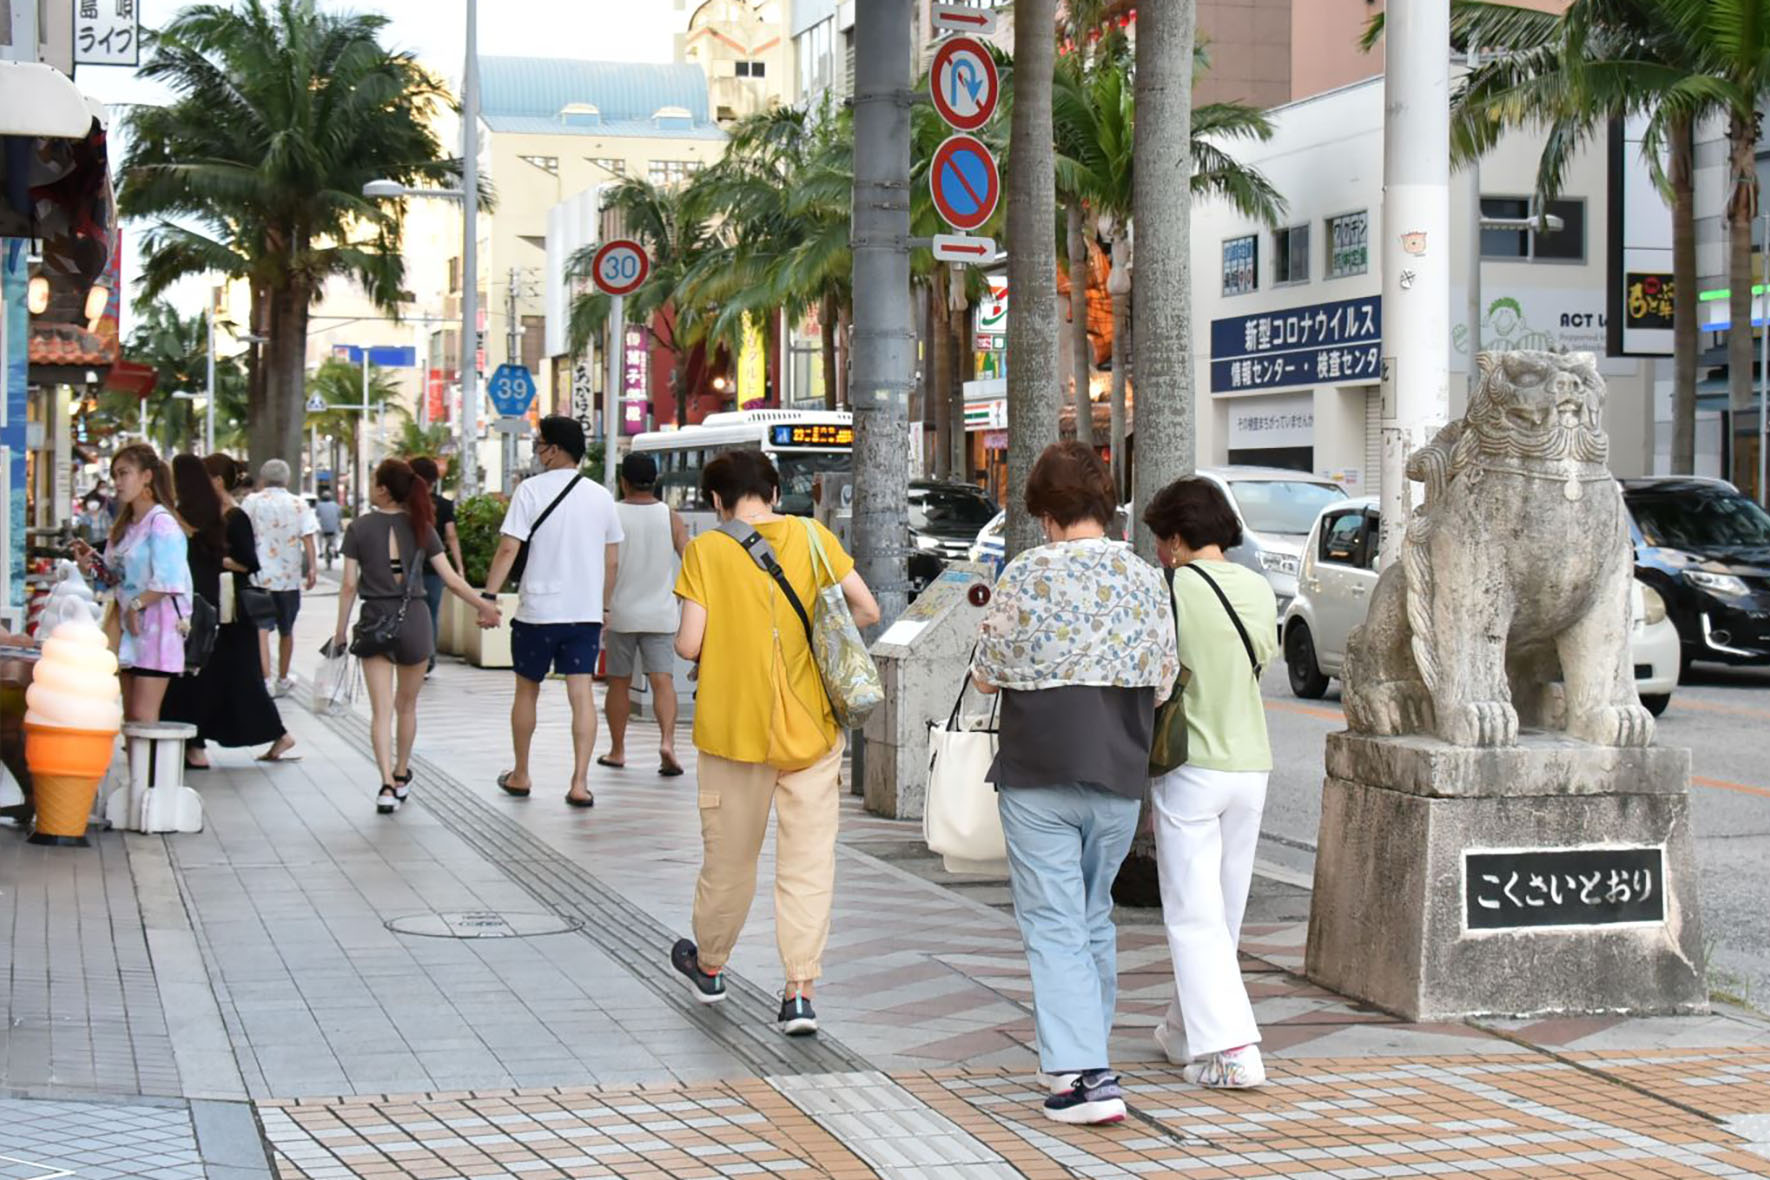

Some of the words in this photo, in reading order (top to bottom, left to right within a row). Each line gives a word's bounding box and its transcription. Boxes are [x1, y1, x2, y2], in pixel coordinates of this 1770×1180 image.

[79, 26, 134, 54] ライブ
[604, 255, 637, 280] 30
[1244, 304, 1375, 352] 新型コロナウイルス
[1560, 312, 1593, 328] ACT
[497, 378, 527, 400] 39
[1477, 868, 1652, 909] こくさいとおり
